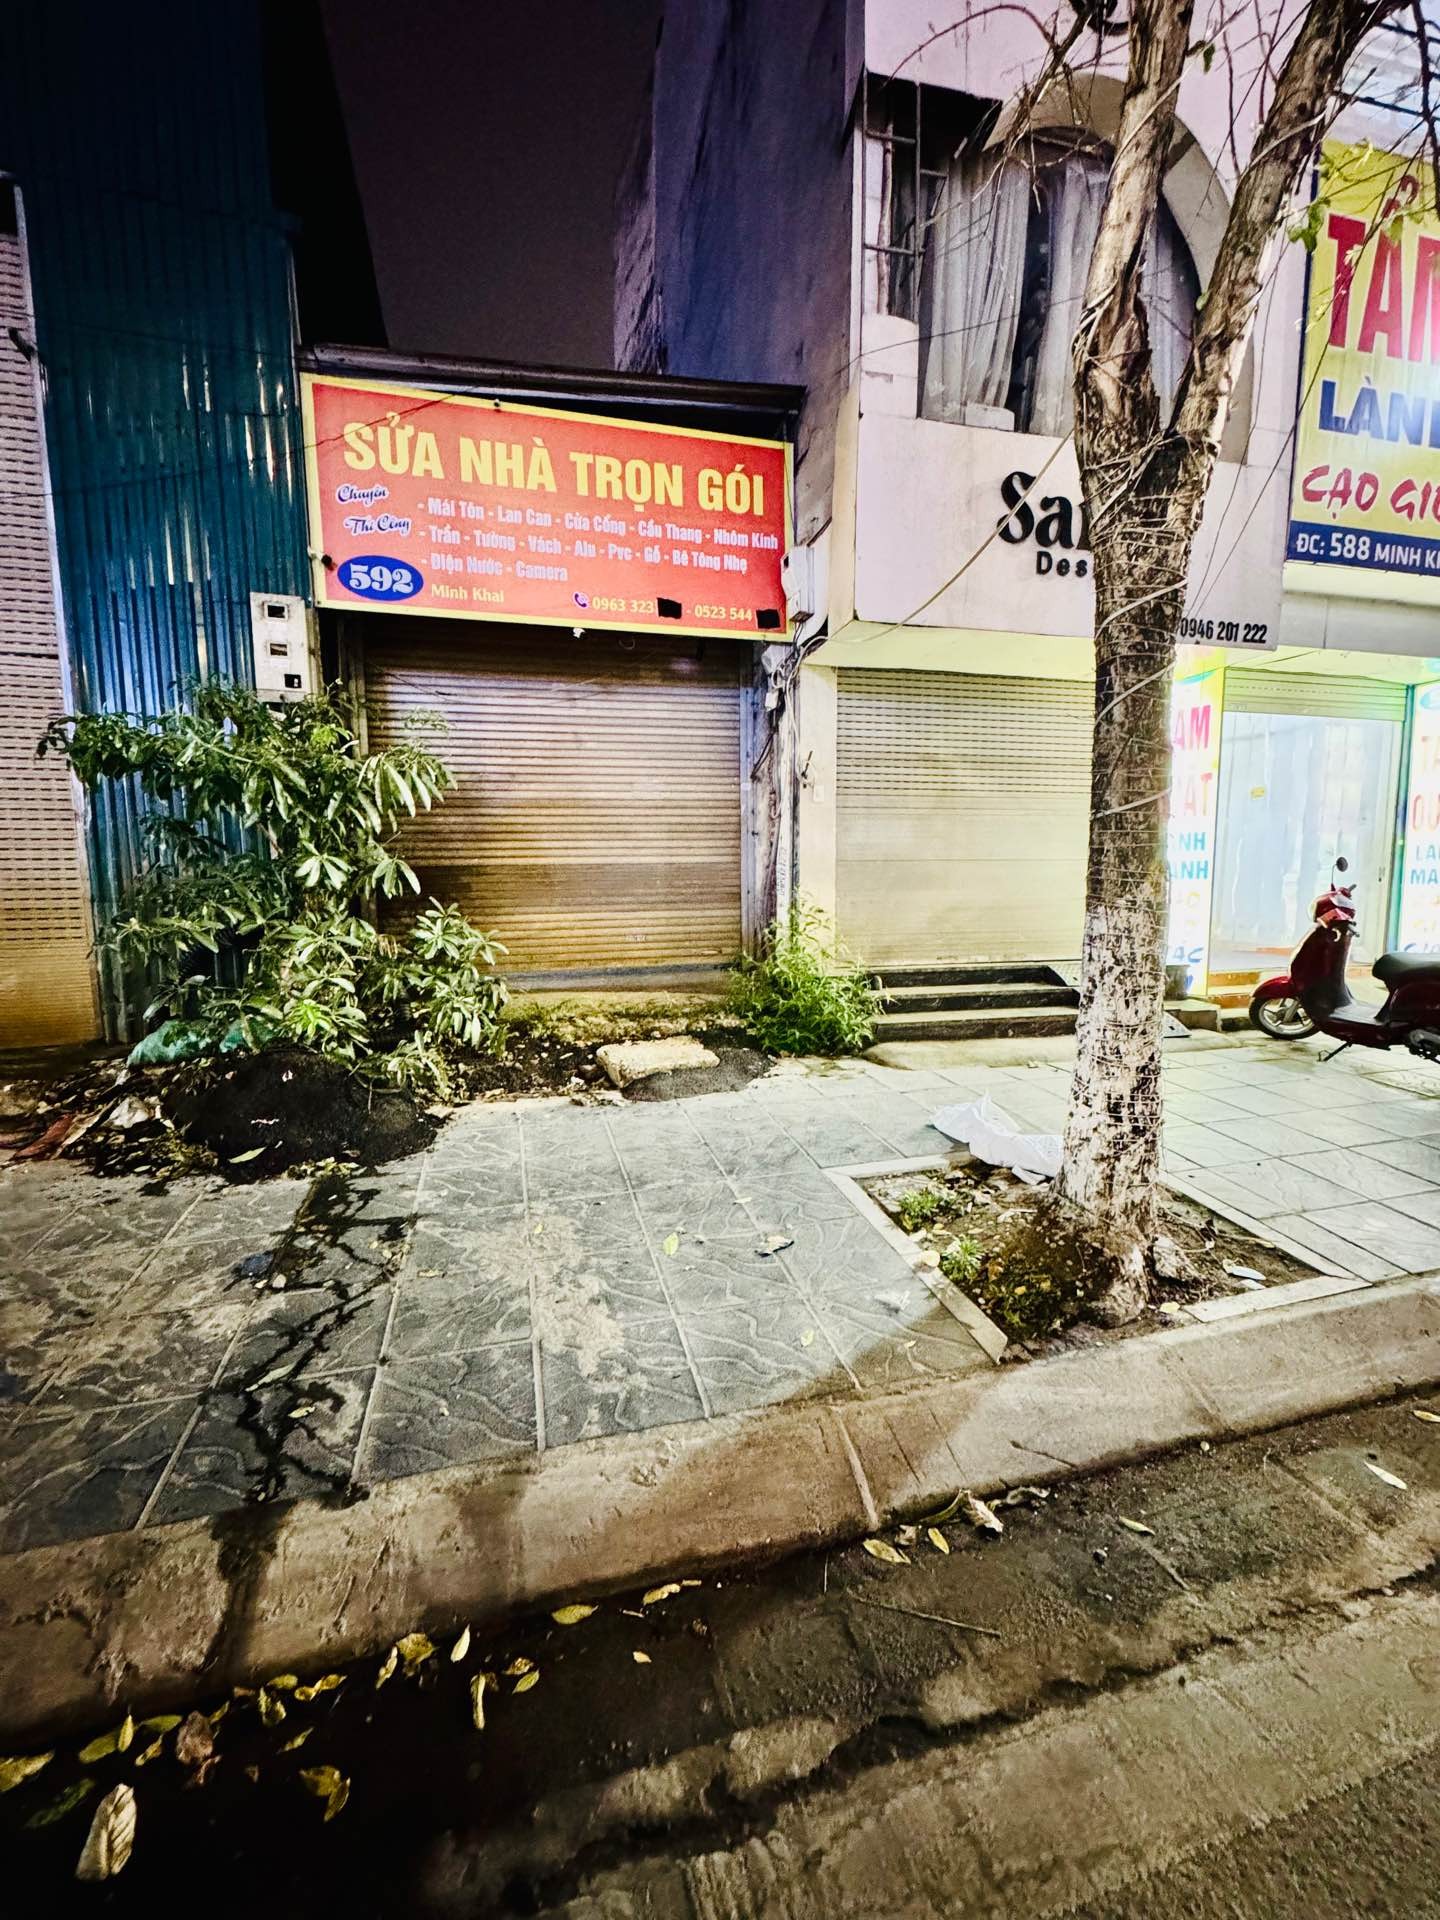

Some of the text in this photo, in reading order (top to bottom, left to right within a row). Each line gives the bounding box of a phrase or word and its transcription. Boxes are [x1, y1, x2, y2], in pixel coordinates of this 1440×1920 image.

[343, 412, 763, 516] SỬA NHÀ TRỌN GÓI
[337, 484, 388, 507] Chuyên
[1302, 464, 1379, 520] CẠO
[344, 514, 411, 537] Thi Công
[428, 497, 455, 516] Mái
[459, 501, 484, 520] Tôn
[498, 505, 522, 524] Lan
[526, 509, 551, 527] Can
[665, 523, 702, 544] Thang
[714, 528, 748, 547] Nhôm
[752, 532, 778, 550] Kính
[473, 529, 516, 552] Tường
[528, 535, 561, 554] Vách
[574, 540, 596, 557] Alu
[608, 543, 632, 561] Pvc
[672, 549, 688, 566] Bê
[691, 551, 720, 571] Tông
[723, 554, 747, 575] Nhẹ
[1296, 532, 1325, 555] ĐC:
[1330, 532, 1371, 560] 588
[1374, 543, 1421, 568] MINH
[349, 563, 414, 594] 592
[467, 556, 503, 576] Nước
[515, 560, 568, 581] Camera
[431, 584, 504, 604] Minh Khai
[592, 597, 752, 621] 0963 323 0523 544
[1180, 617, 1268, 644] 0946 201 222
